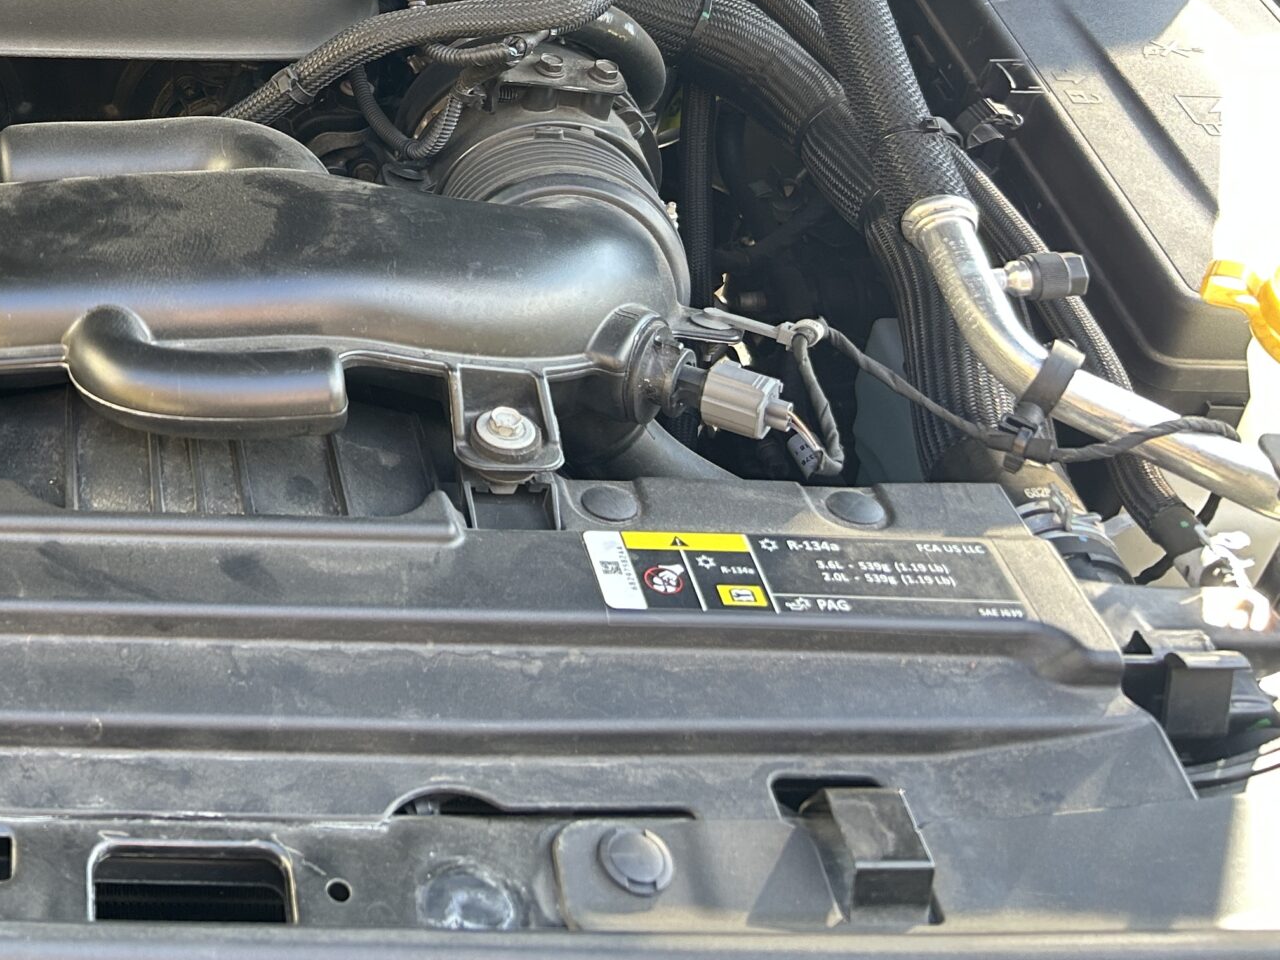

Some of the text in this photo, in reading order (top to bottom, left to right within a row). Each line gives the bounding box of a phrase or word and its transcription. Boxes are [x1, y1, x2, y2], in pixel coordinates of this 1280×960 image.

[786, 539, 986, 554] R-134a FCA US LLC
[720, 565, 755, 575] R-134a
[816, 560, 845, 570] 3.6L
[858, 561, 893, 573] 539g
[894, 561, 927, 573] (1.19
[822, 572, 850, 582] 2.0L
[864, 573, 898, 585] 539g
[900, 574, 934, 586] (1.19
[816, 599, 852, 613] PAG
[978, 607, 1000, 617] SAE
